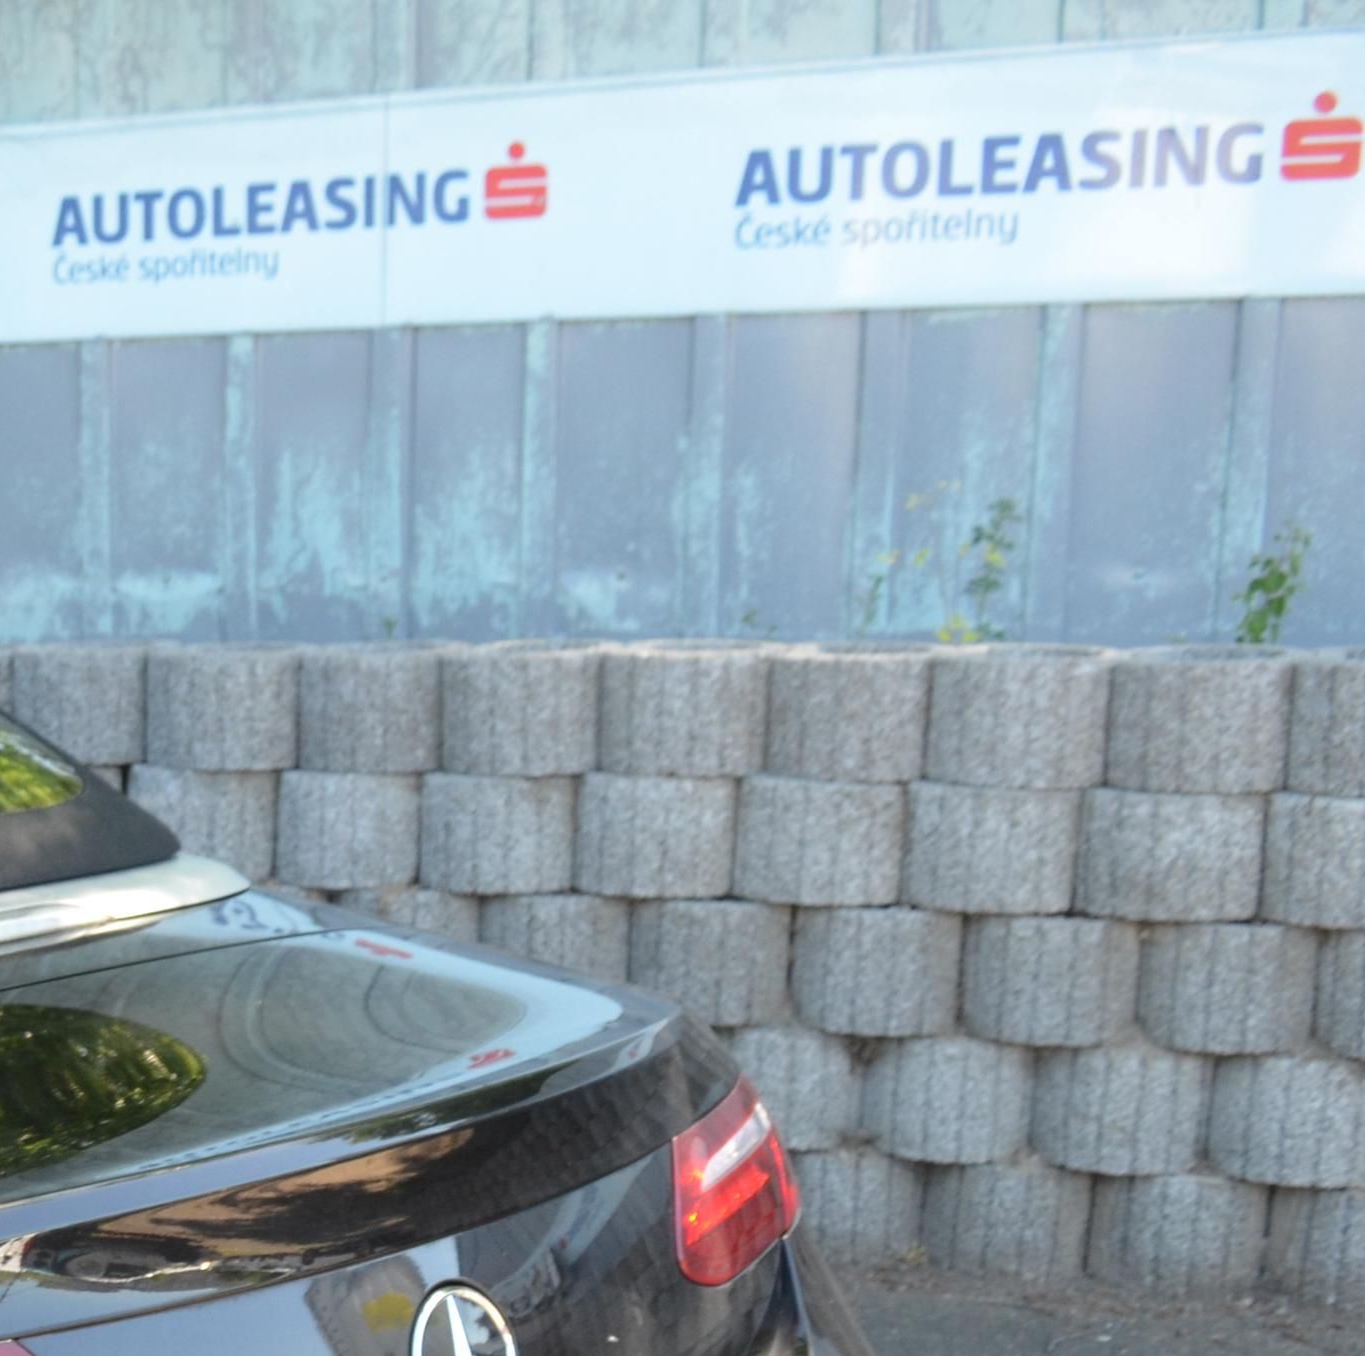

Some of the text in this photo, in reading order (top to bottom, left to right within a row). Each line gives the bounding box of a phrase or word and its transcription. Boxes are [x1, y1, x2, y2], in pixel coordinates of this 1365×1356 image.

[735, 121, 1264, 207] AUTOLEASING
[51, 169, 469, 247] AUTOLEASING
[735, 212, 830, 249] České
[52, 249, 129, 285] České
